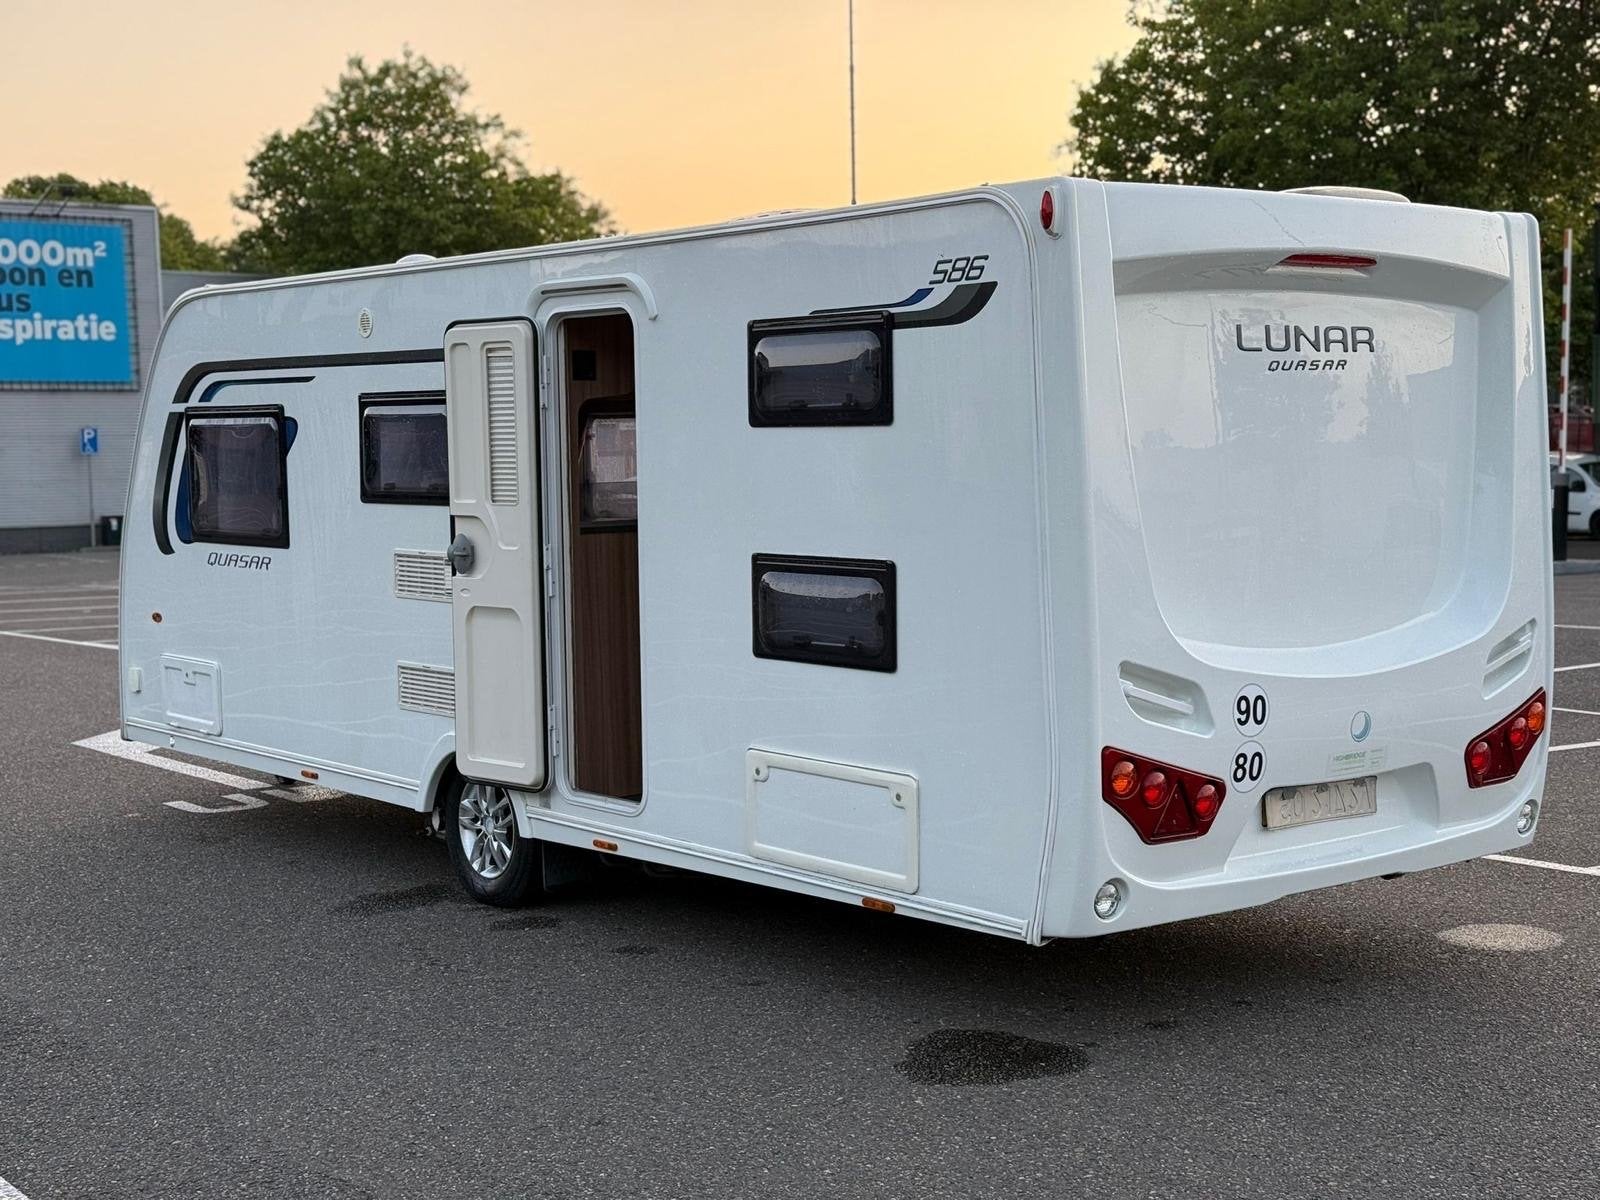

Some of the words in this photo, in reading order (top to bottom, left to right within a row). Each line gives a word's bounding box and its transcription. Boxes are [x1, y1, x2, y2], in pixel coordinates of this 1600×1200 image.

[57, 268, 94, 288] en
[928, 254, 989, 285] 586
[0, 312, 117, 345] spiratie
[1235, 324, 1375, 353] LUNAR
[1267, 359, 1348, 372] QUASAR
[84, 428, 96, 443] P
[207, 552, 272, 571] QUASAR
[1236, 695, 1267, 727] 90
[1232, 751, 1263, 783] 80
